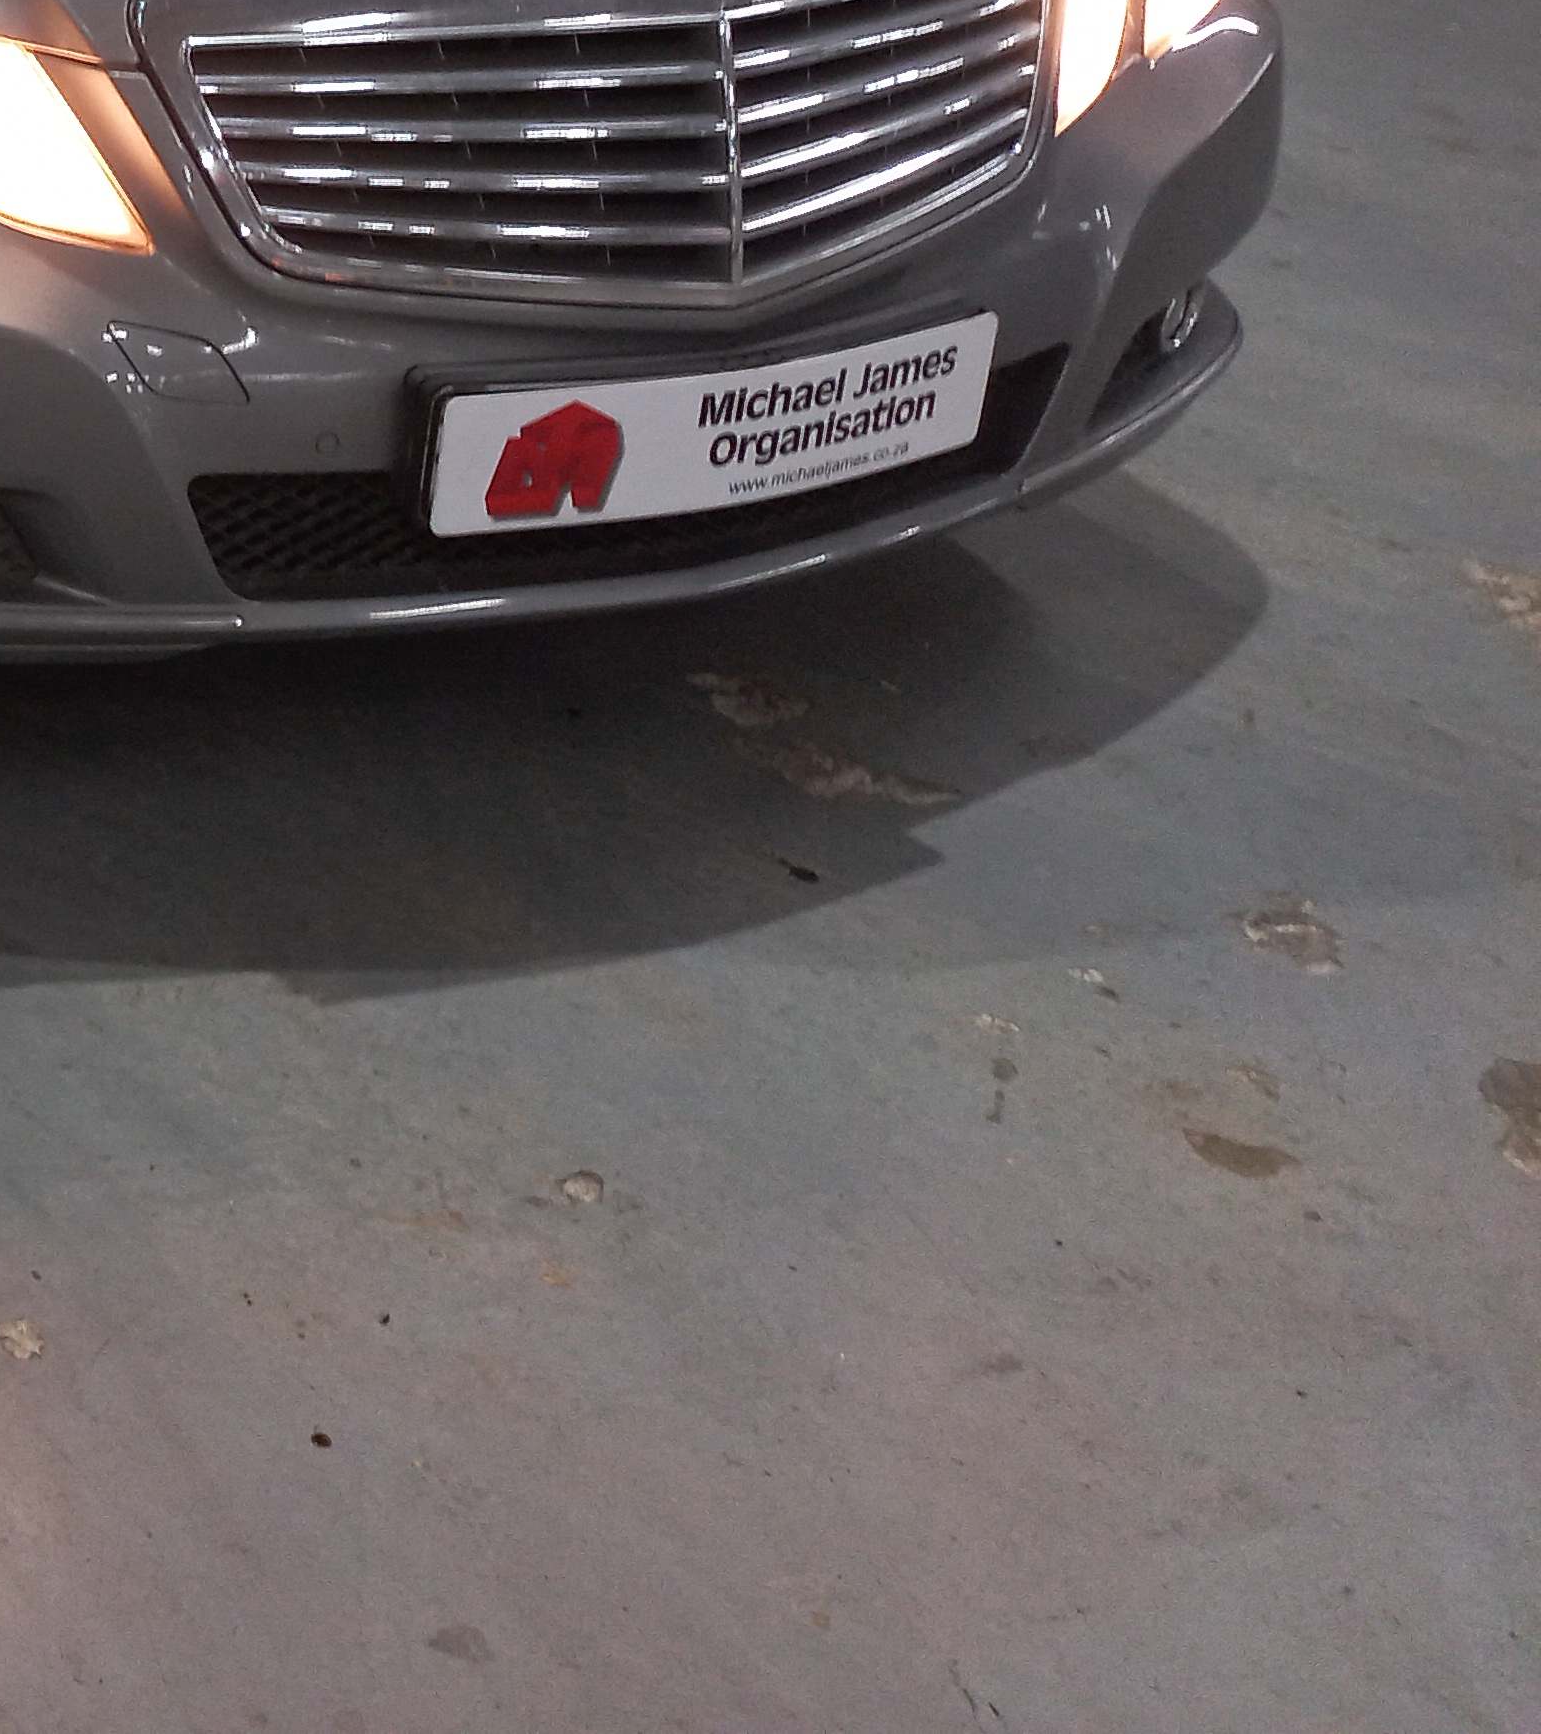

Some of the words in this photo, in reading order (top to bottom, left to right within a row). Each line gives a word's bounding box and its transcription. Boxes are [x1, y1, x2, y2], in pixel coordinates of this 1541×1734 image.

[698, 367, 848, 428] Michael
[853, 345, 958, 399] James
[709, 390, 936, 467] Organisation
